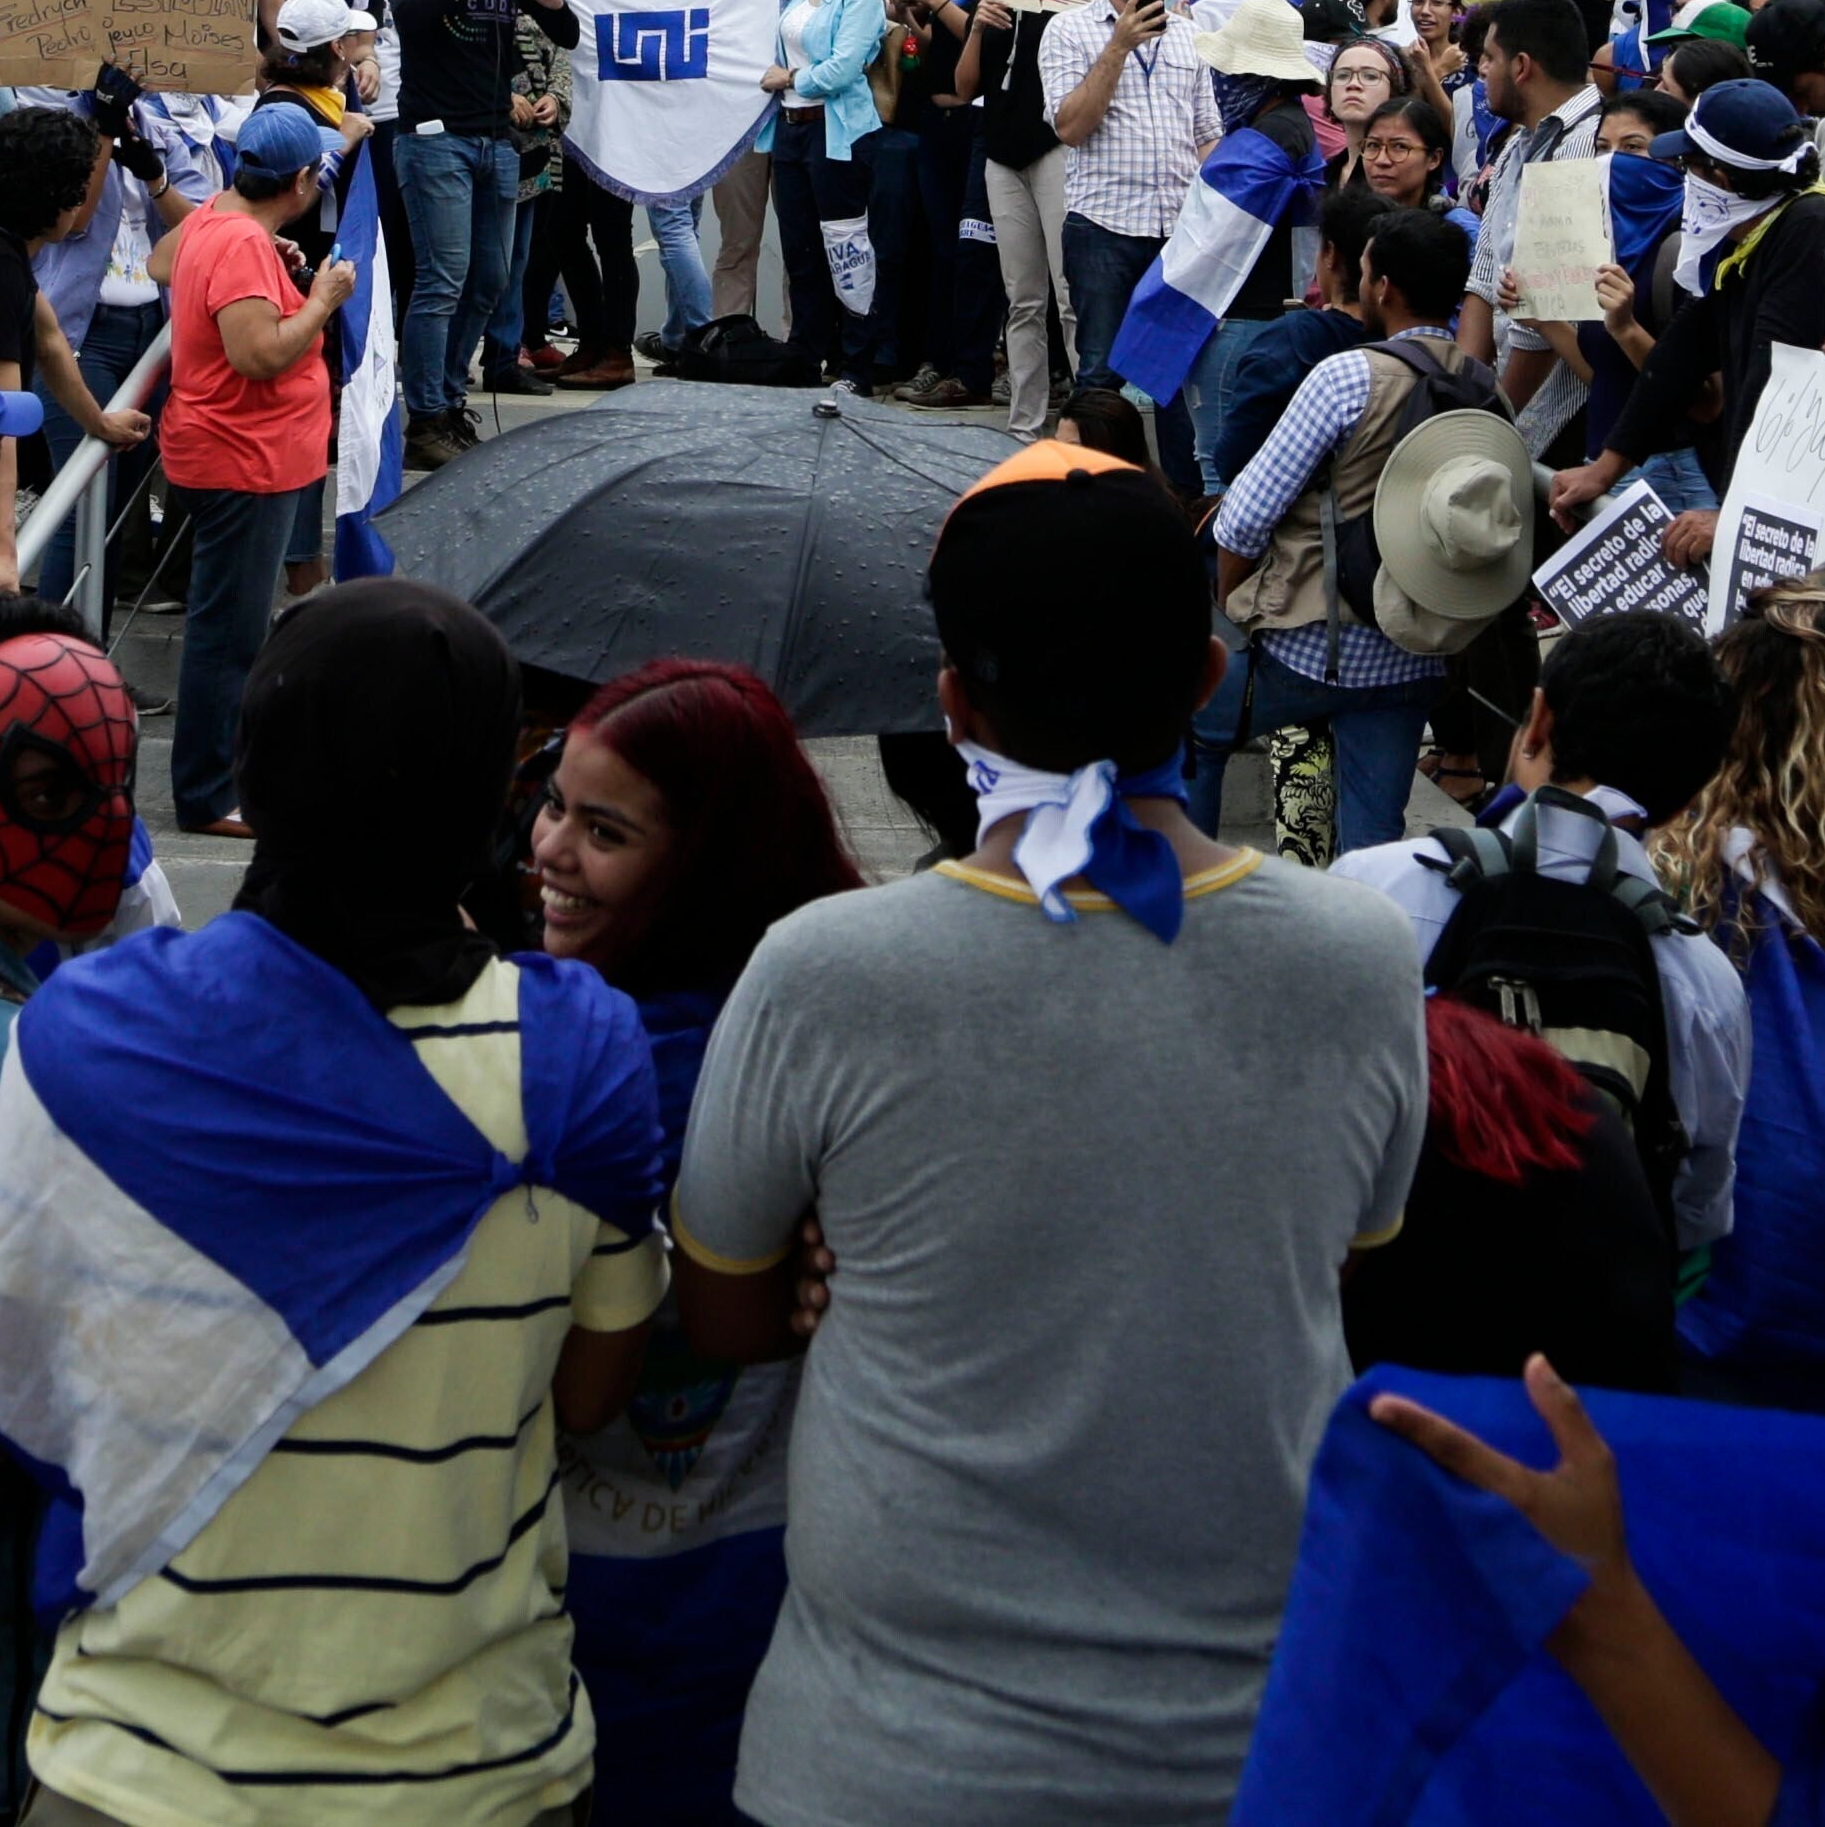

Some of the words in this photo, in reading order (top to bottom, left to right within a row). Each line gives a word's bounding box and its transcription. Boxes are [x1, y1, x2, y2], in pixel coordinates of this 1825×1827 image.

[26, 25, 92, 59] Pedro
[1575, 534, 1627, 587] secreto
[1622, 518, 1647, 541] de
[1638, 503, 1665, 525] la
[1738, 537, 1777, 572] libertad
[1775, 554, 1807, 579] radica
[1754, 522, 1791, 550] secreto
[1789, 529, 1805, 556] de
[1567, 559, 1631, 621] libertad
[1615, 561, 1667, 612] educar
[1741, 569, 1754, 590] en
[641, 1501, 689, 1534] DE
